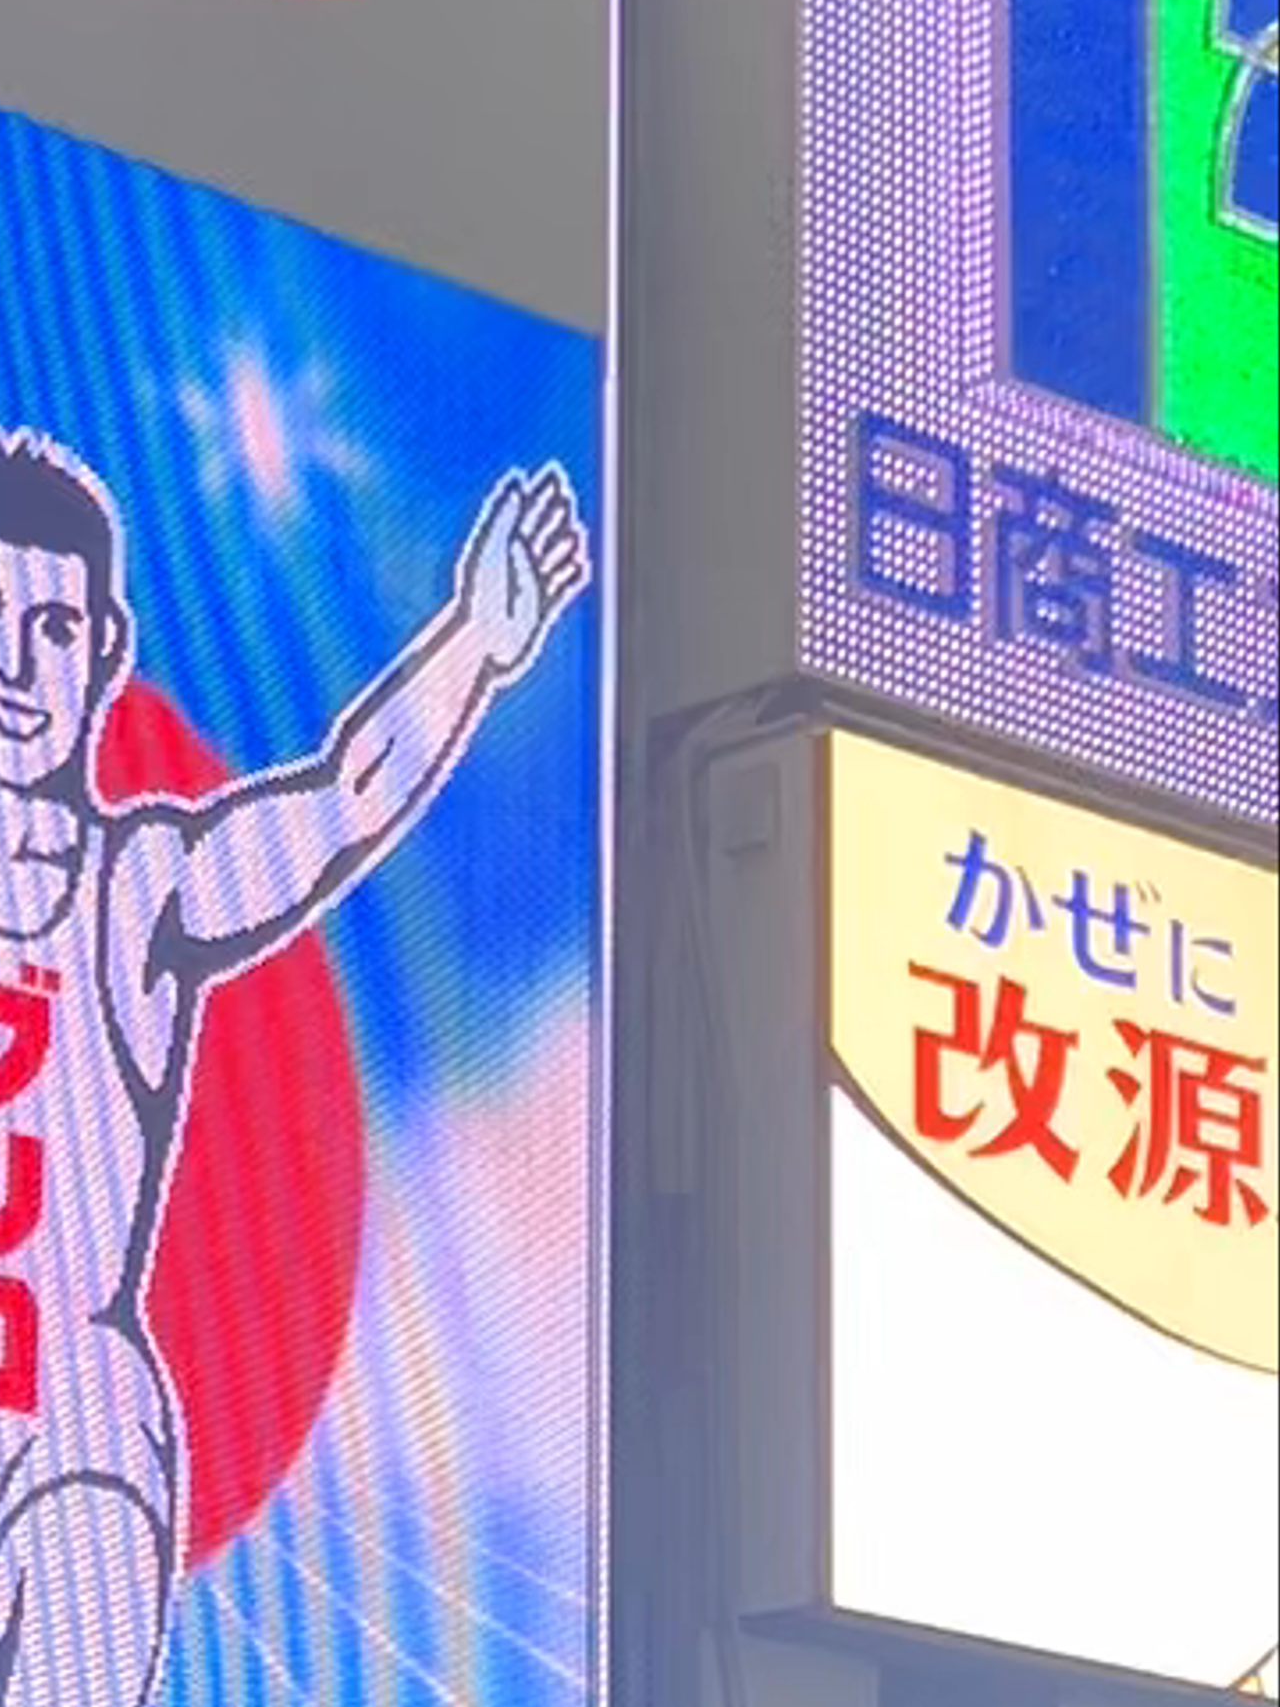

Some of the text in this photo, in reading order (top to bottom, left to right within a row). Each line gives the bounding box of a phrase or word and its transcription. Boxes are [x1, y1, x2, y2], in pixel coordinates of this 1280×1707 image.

[855, 410, 1279, 723] 日商エ
[944, 829, 1236, 1016] かぜに
[908, 959, 1270, 1227] 改源
